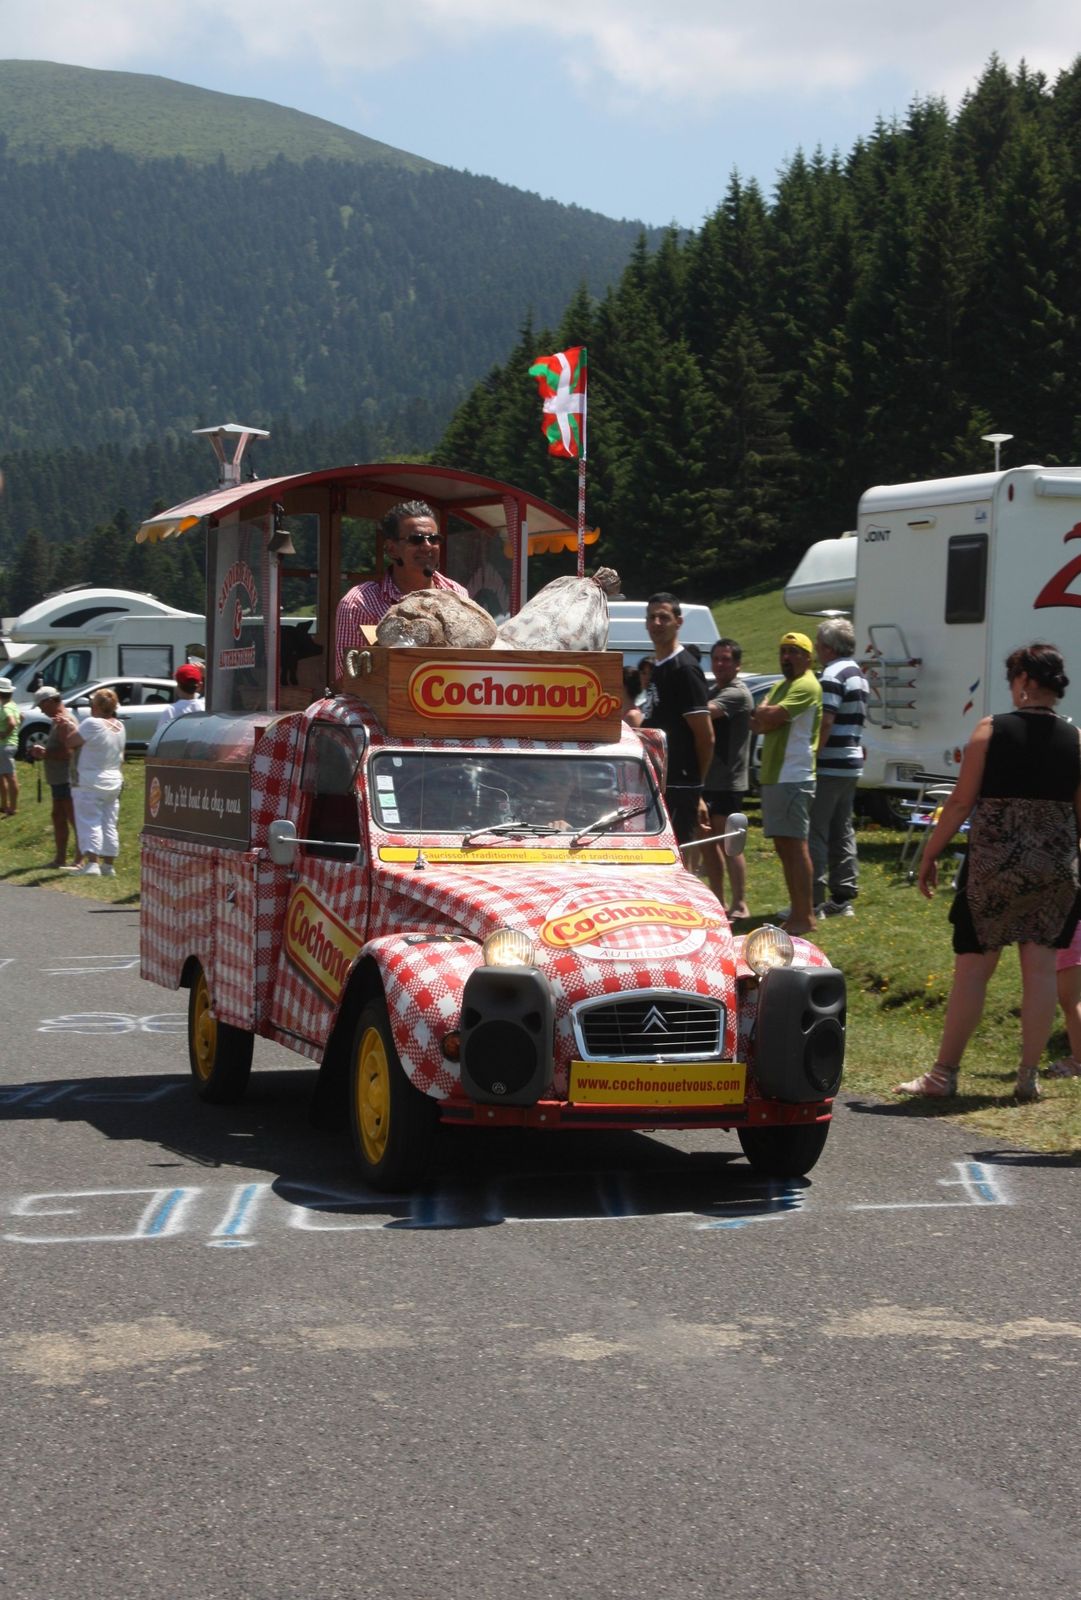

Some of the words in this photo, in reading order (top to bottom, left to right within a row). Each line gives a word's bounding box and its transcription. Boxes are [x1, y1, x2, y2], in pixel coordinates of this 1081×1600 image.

[421, 675, 588, 708] Cochonou
[188, 786, 201, 809] bout
[201, 788, 210, 810] de
[210, 789, 224, 819] chez
[225, 798, 241, 814] nous
[423, 851, 469, 862] Saucisson
[471, 851, 527, 861] traditionnel
[553, 904, 698, 941] Cochonou
[576, 1077, 741, 1093] www.cochonouetvous.com
